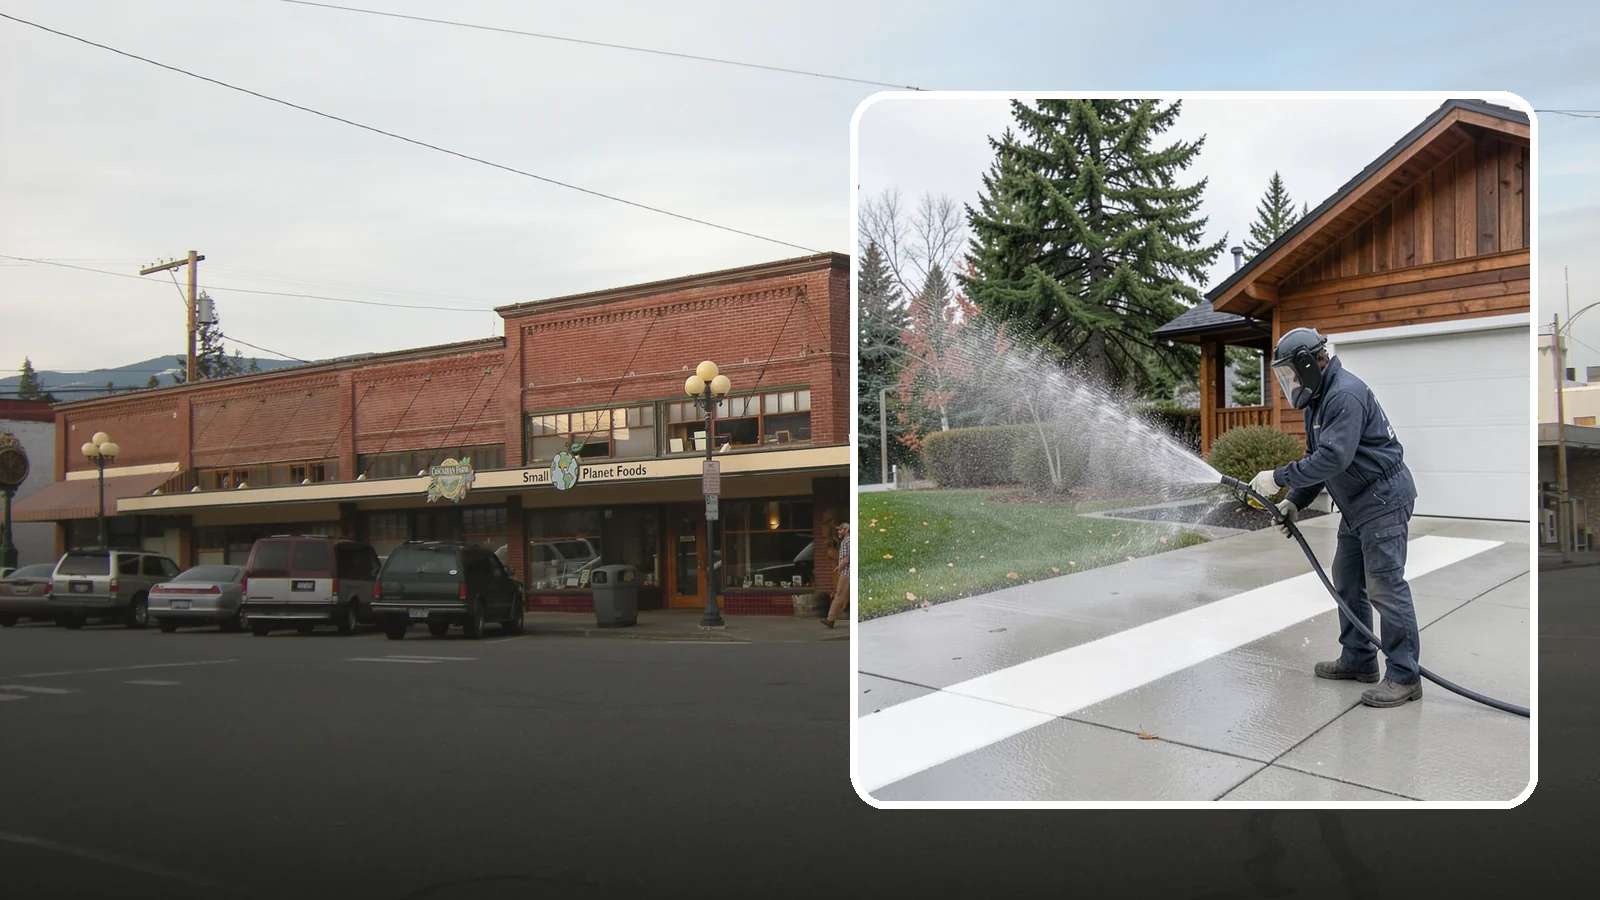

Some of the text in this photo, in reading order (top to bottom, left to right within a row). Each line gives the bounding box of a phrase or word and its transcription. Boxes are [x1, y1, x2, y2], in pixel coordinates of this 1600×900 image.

[523, 464, 647, 483] Small Planet Foods
